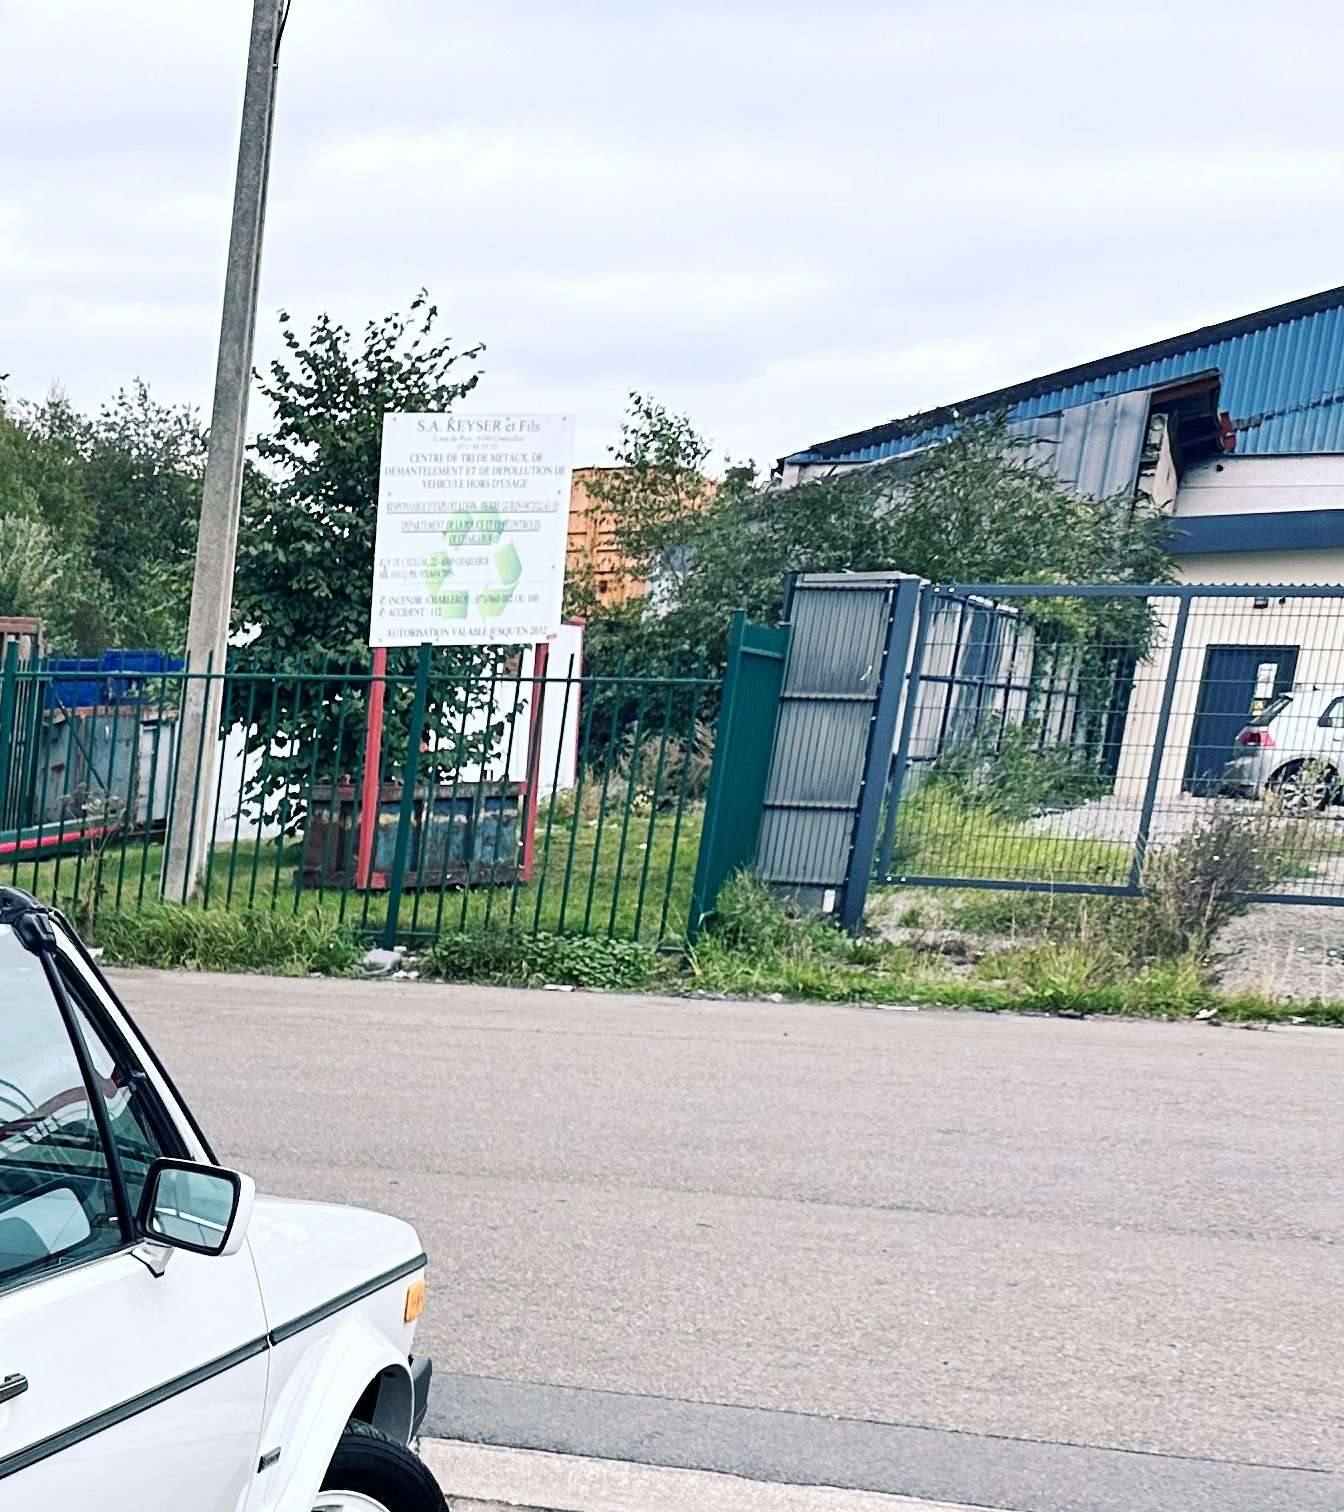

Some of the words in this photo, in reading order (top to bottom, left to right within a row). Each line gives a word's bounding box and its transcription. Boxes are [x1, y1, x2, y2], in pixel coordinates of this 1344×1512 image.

[447, 419, 502, 432] KEYSER
[505, 421, 516, 432] et
[519, 420, 541, 432] Fils
[409, 453, 444, 463] CENTRE
[446, 453, 458, 463] DE
[476, 453, 488, 463] DE
[532, 452, 544, 463] DE
[465, 466, 477, 476] ET
[479, 466, 490, 476] DE
[466, 479, 490, 488] HORS
